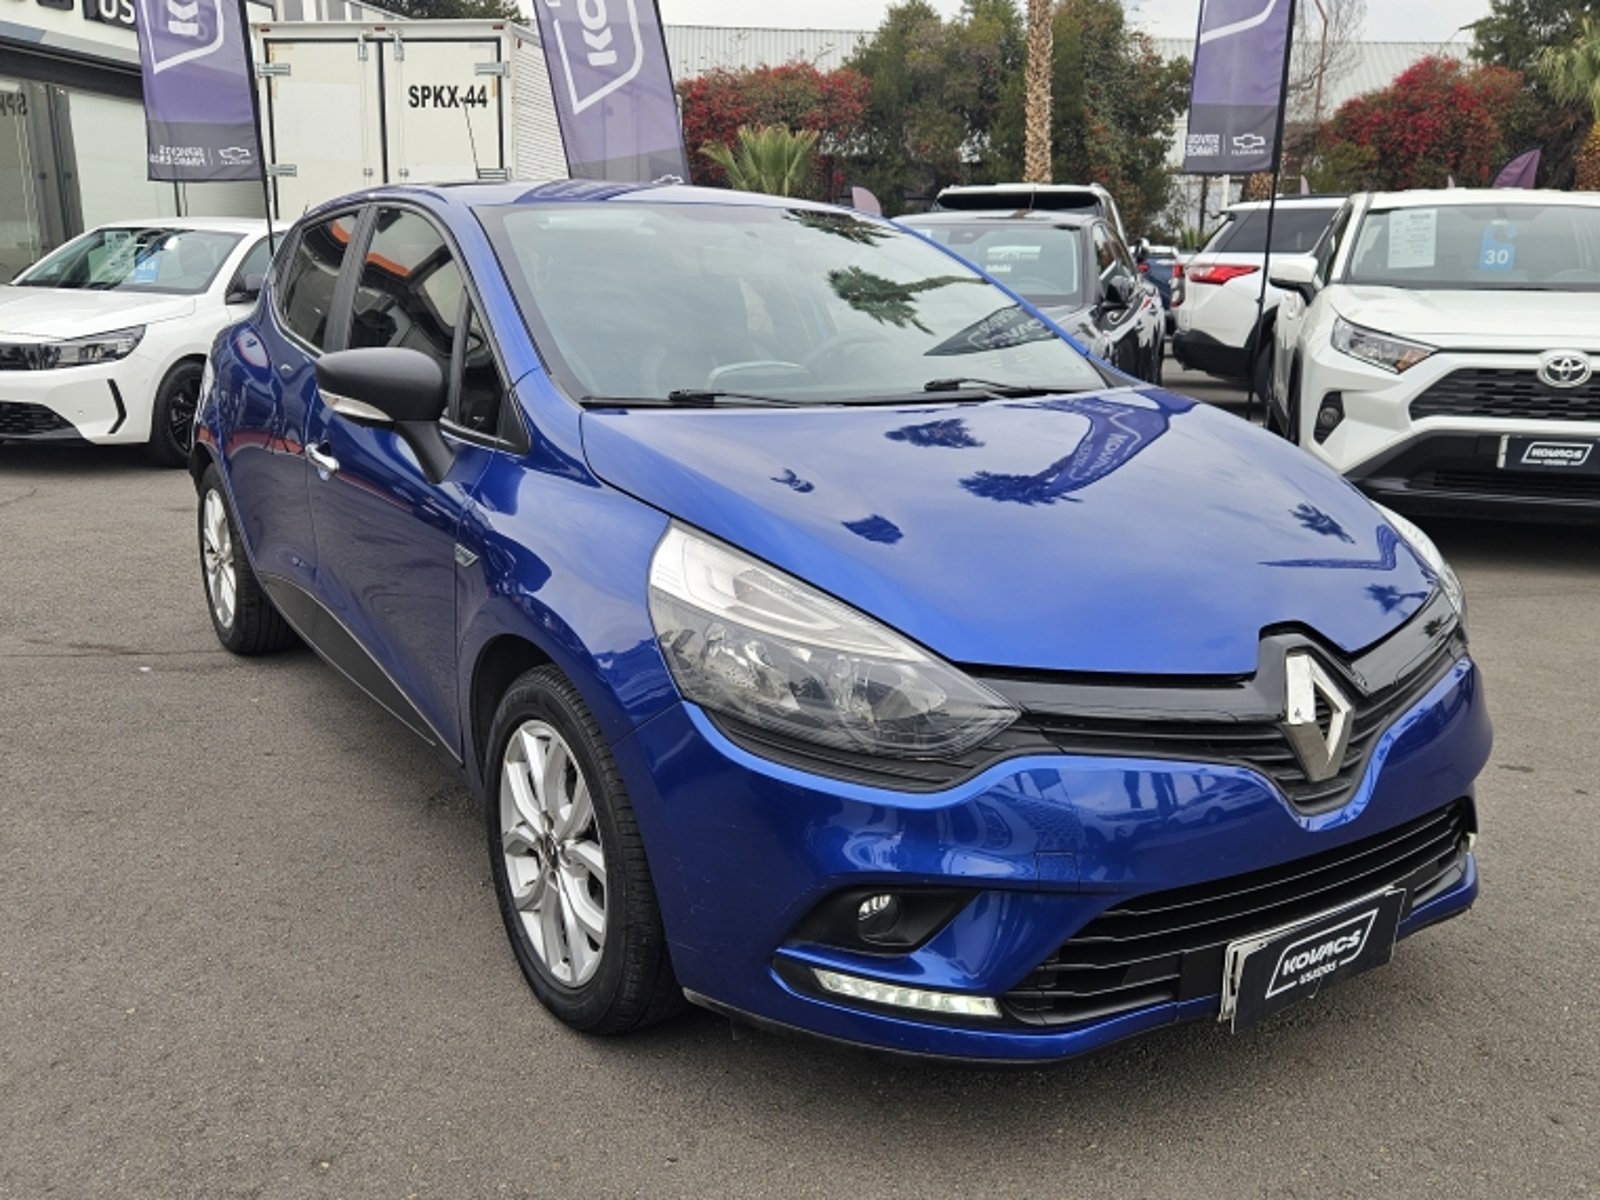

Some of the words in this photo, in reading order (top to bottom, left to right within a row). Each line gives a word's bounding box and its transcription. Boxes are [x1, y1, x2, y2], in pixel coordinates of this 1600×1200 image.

[408, 85, 488, 108] SPKX-44
[1484, 250, 1508, 265] 30
[1282, 929, 1361, 975] KOVACS
